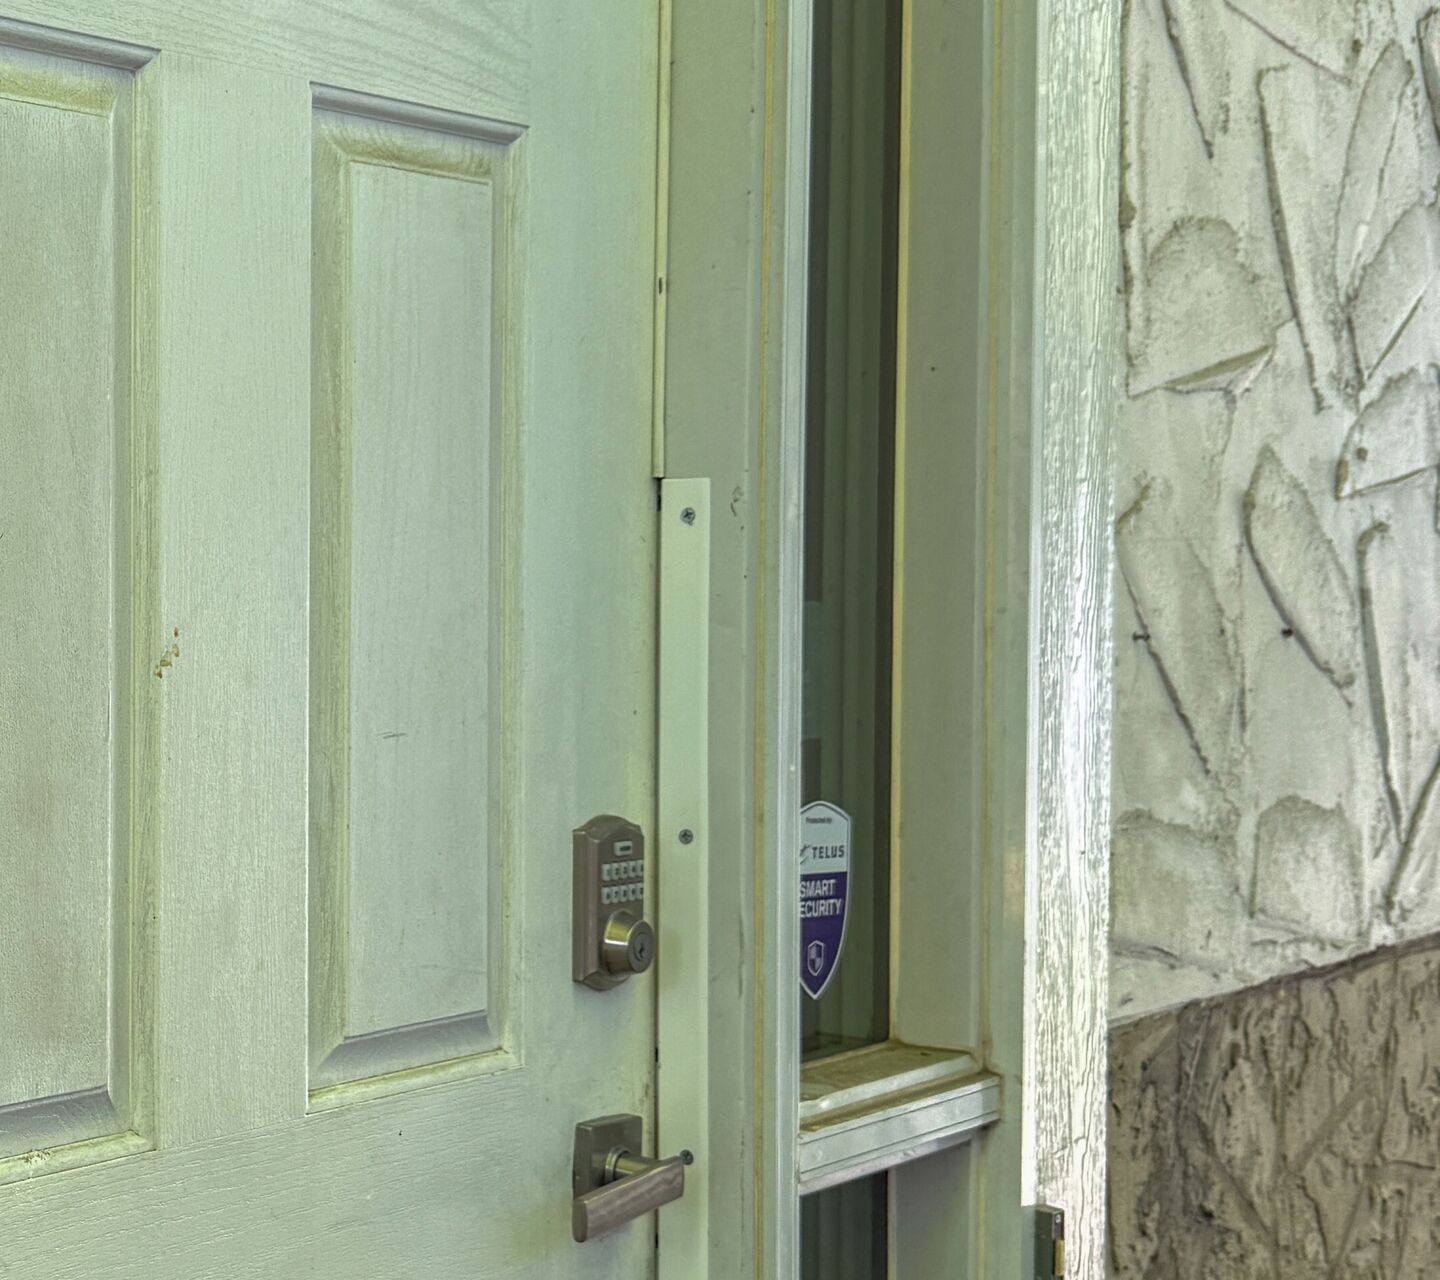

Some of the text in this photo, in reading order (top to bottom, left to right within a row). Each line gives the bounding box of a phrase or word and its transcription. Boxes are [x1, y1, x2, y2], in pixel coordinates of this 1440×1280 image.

[811, 845, 846, 860] TELUS
[800, 879, 836, 899] SMART
[800, 899, 842, 919] ECURITY
